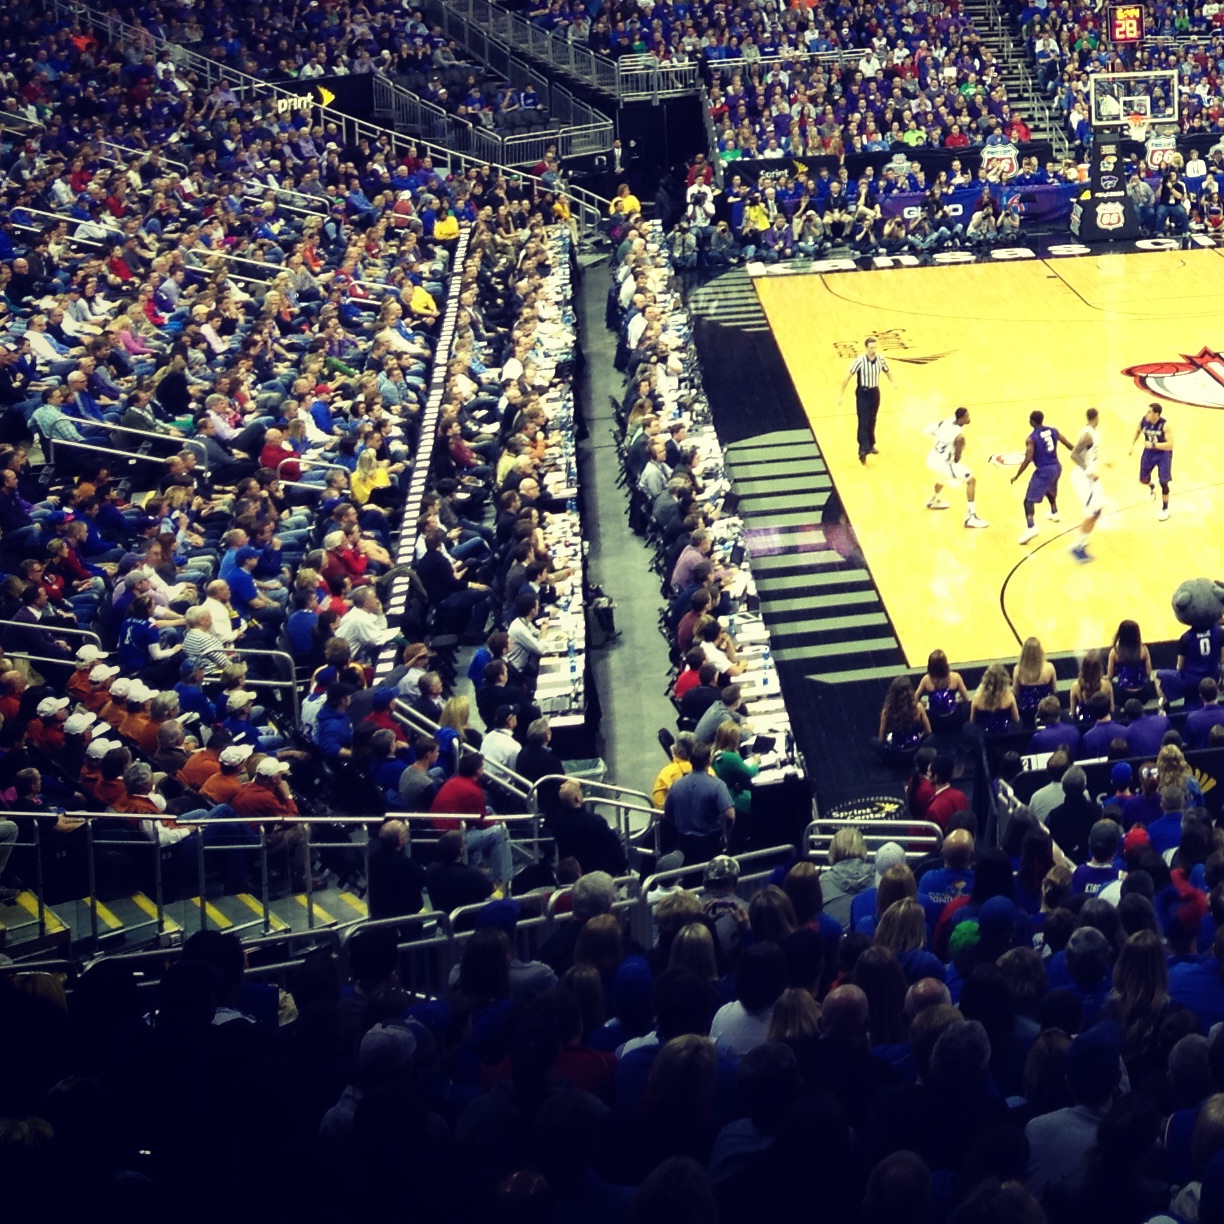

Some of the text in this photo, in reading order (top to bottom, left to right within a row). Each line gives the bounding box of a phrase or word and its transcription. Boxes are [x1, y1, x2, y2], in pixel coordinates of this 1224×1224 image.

[1116, 20, 1137, 38] 28
[278, 92, 314, 114] print
[1044, 436, 1054, 451] 3
[1200, 638, 1211, 655] 0
